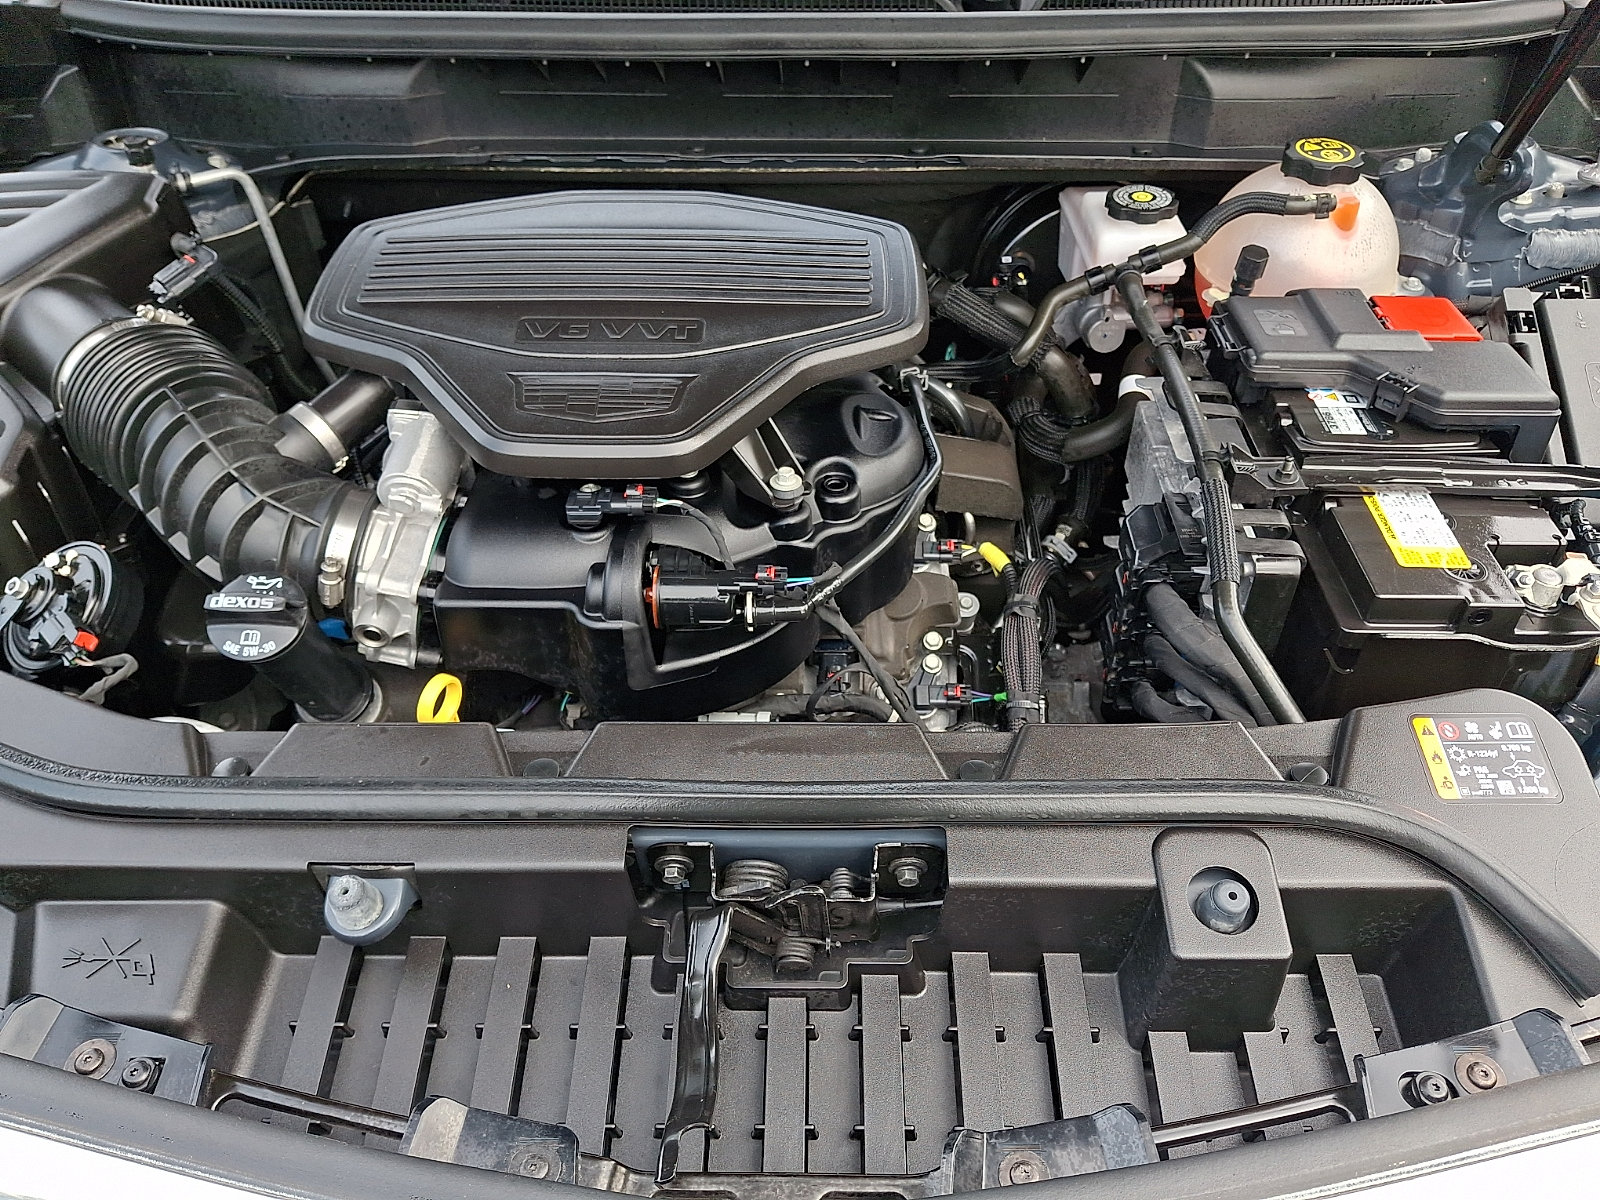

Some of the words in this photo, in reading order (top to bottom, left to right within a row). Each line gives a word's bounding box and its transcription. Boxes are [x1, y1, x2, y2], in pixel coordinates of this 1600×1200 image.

[524, 320, 591, 340] V6
[600, 321, 699, 340] VVT
[209, 593, 275, 610] dexos
[222, 640, 242, 656] SAE
[242, 640, 277, 657] 5W-30
